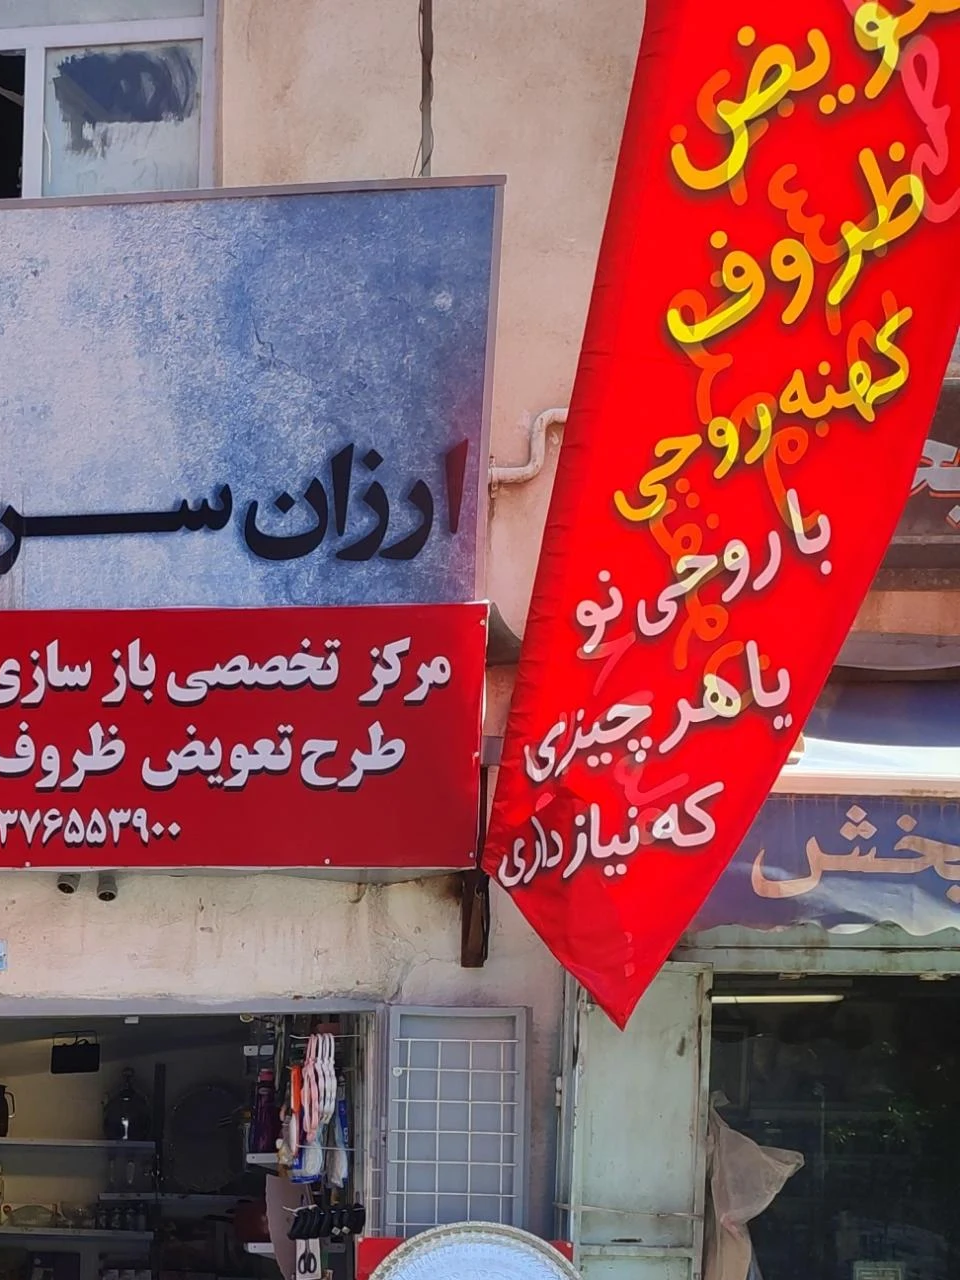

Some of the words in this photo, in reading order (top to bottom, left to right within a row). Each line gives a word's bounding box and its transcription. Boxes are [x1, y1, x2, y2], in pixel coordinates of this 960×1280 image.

[667, 141, 925, 343] ظروف
[778, 307, 913, 422] کهنه
[242, 438, 469, 562] ارزان
[614, 402, 772, 521] روحی
[786, 488, 833, 575] با
[575, 570, 624, 653] نو
[637, 530, 782, 636] روحی
[101, 637, 157, 703] باز
[166, 637, 341, 703] تخصصی
[358, 636, 452, 702] مرکز
[745, 639, 793, 731] یا
[300, 720, 407, 788] طرح
[524, 700, 654, 783] چیزی
[658, 672, 742, 754] هر
[141, 724, 294, 788] تعویض
[499, 815, 564, 888] داری
[562, 802, 641, 879] نیاز
[651, 780, 725, 848] که
